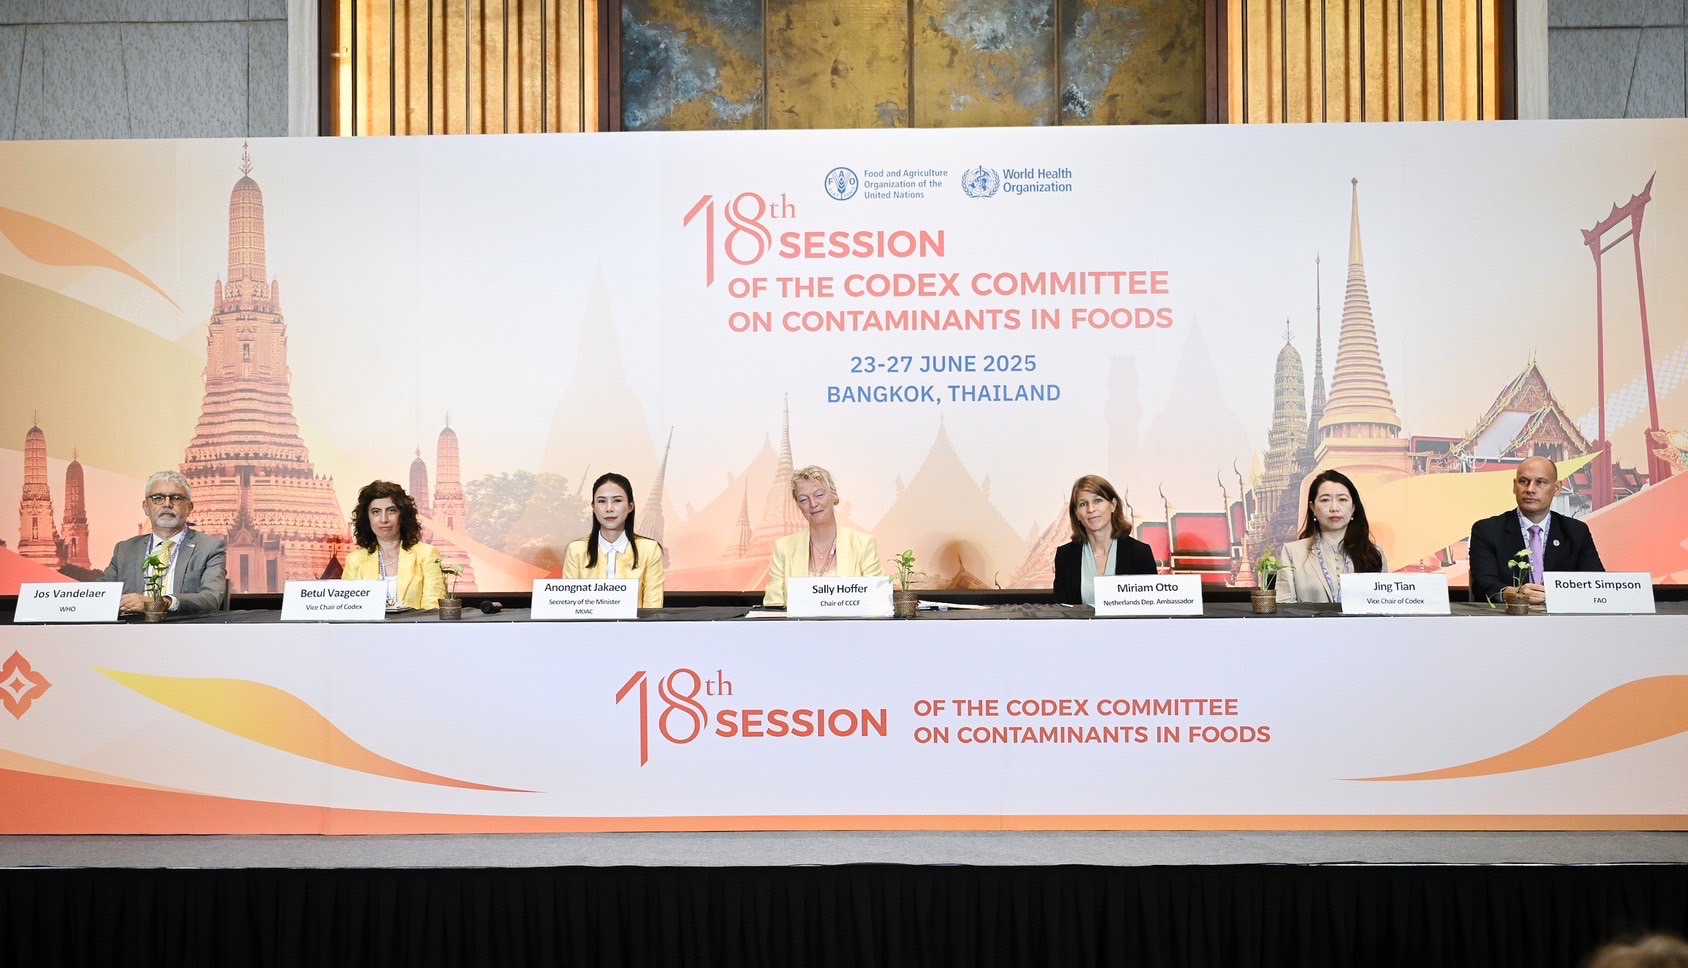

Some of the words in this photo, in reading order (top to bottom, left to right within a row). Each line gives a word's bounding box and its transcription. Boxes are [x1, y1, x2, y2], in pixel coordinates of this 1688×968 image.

[865, 169, 883, 177] Food
[887, 169, 901, 177] and
[903, 169, 948, 179] Agriculture
[1003, 168, 1034, 179] World
[1038, 168, 1071, 178] Health
[864, 180, 915, 190] Organization
[1003, 181, 1072, 195] Organization
[865, 191, 890, 199] United
[779, 230, 944, 258] SESSION
[728, 278, 767, 298] OF
[776, 277, 834, 298] THE
[844, 273, 960, 297] CODEX
[971, 271, 1169, 296] COMMITTEE
[729, 312, 771, 332] ON
[783, 309, 1020, 332] CONTAMINANTS
[1032, 309, 1060, 329] IN
[1072, 308, 1173, 329] FOODS
[851, 356, 912, 373] 23-27
[920, 356, 976, 372] JUNE
[984, 355, 1036, 372] 2025
[828, 386, 940, 405] BANGKOK,
[948, 385, 1060, 401] THAILAND
[545, 584, 591, 594] Anongnat
[594, 583, 626, 592] Jakaeo
[813, 585, 834, 596] Sally
[837, 584, 867, 594] Hoffer
[1118, 584, 1153, 593] Miriam
[1156, 583, 1178, 592] Otto
[1374, 582, 1392, 593] Jing
[1394, 582, 1416, 592] Tian
[1555, 580, 1591, 589] Robert
[1595, 580, 1641, 592] Simpson
[34, 590, 49, 599] Jos
[54, 589, 105, 598] Vandelaer
[301, 589, 325, 598] Betul
[328, 589, 370, 600] Vazgecer
[1141, 599, 1155, 607] Dep.
[1156, 598, 1194, 606] Ambassador
[914, 700, 945, 716] OF
[952, 700, 998, 716] THE
[1007, 700, 1089, 716] CODEX
[1097, 699, 1238, 716] COMMITTEE
[715, 709, 887, 737] SESSION
[914, 727, 949, 743] ON
[958, 726, 1148, 743] CONTAMINANTS
[1157, 727, 1179, 743] IN
[1190, 726, 1270, 743] FOODS
